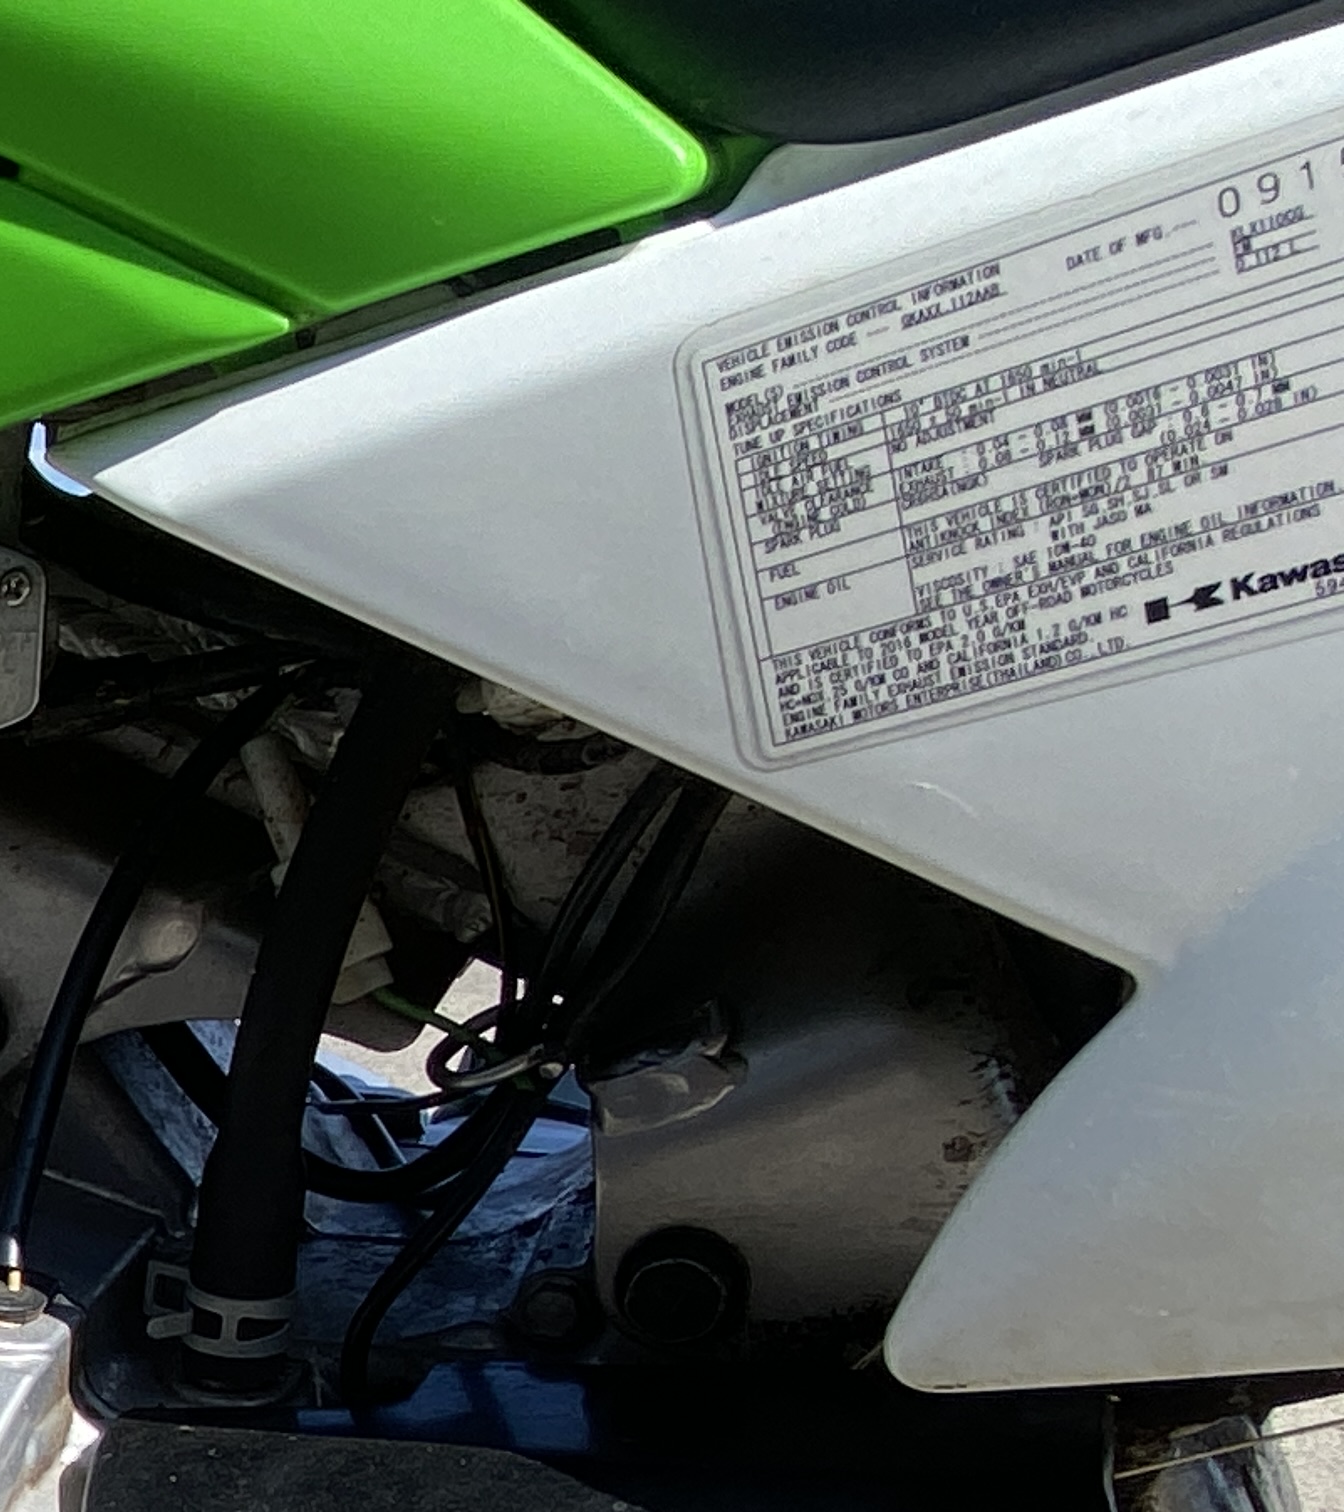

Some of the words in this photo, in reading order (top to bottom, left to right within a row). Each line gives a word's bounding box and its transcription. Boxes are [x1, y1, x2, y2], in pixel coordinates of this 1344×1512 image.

[1066, 245, 1101, 271] DATE
[1108, 237, 1126, 256] OF
[717, 344, 770, 373] VEHICLE
[777, 320, 838, 352] EMISSION
[846, 297, 901, 327] CONTROL
[911, 262, 999, 304] INFORMATION
[772, 345, 818, 373] FAMILY
[826, 332, 856, 354] CODE
[856, 352, 913, 383] CONTROL
[920, 333, 969, 362] SYSTEM
[792, 389, 901, 437] SPECIFICATIONS
[769, 561, 799, 583] FUEL
